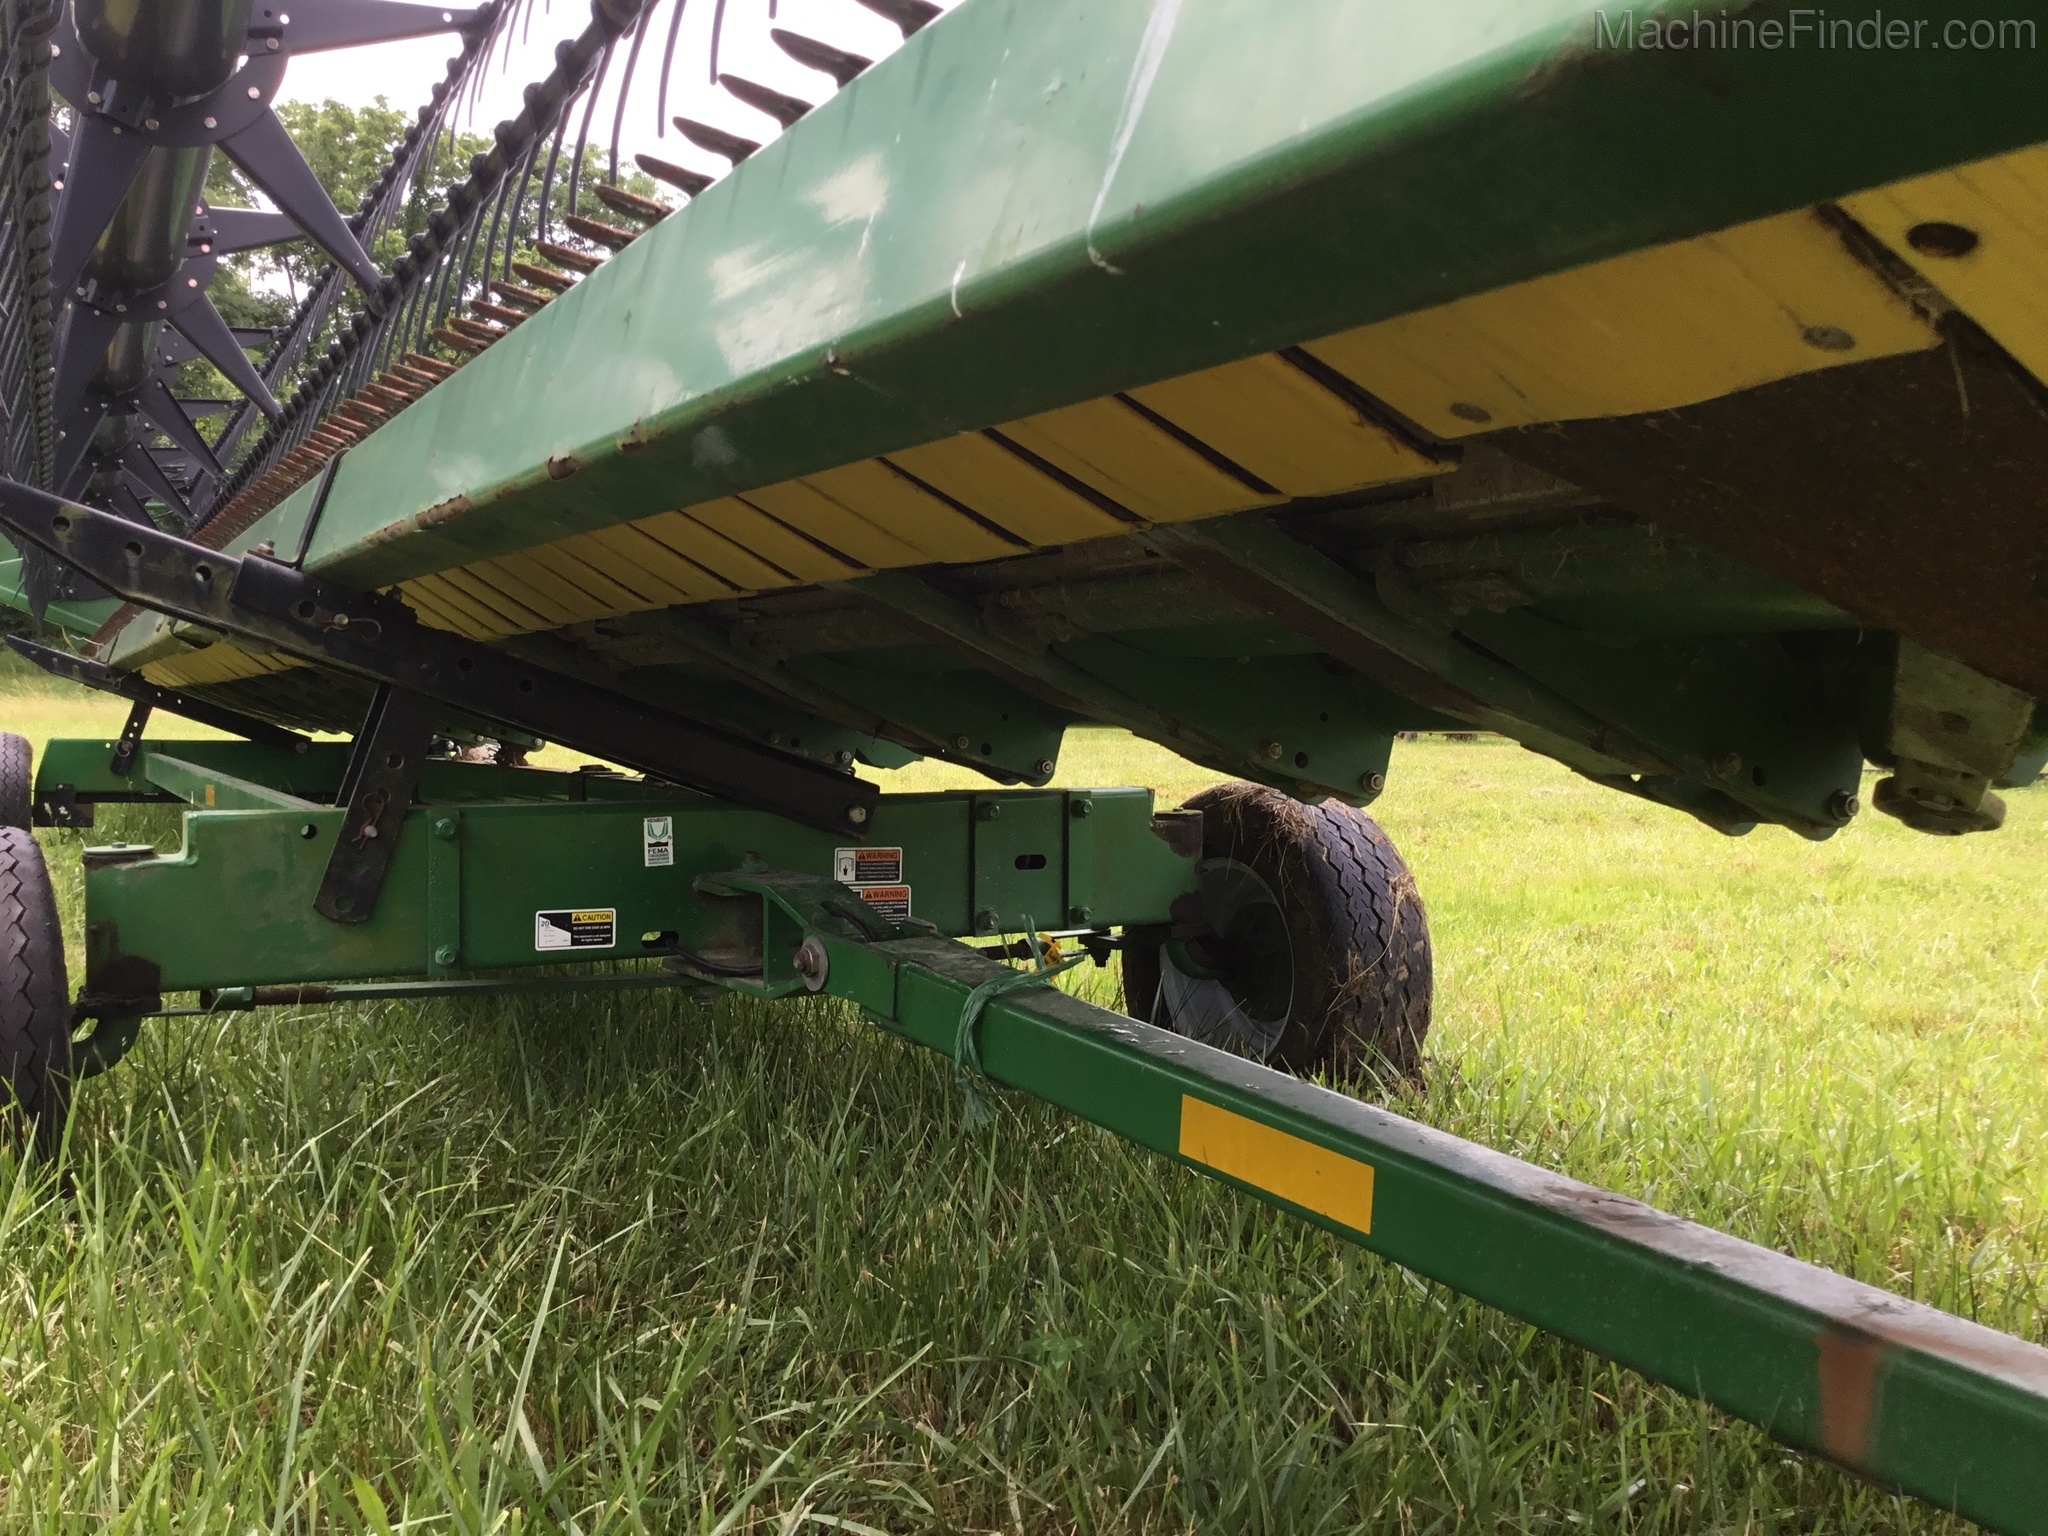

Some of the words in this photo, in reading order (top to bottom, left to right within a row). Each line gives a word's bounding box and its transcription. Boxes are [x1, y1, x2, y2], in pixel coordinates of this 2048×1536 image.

[865, 852, 898, 860] WARNING
[872, 890, 907, 899] WARNING
[582, 913, 611, 922] CAUTION
